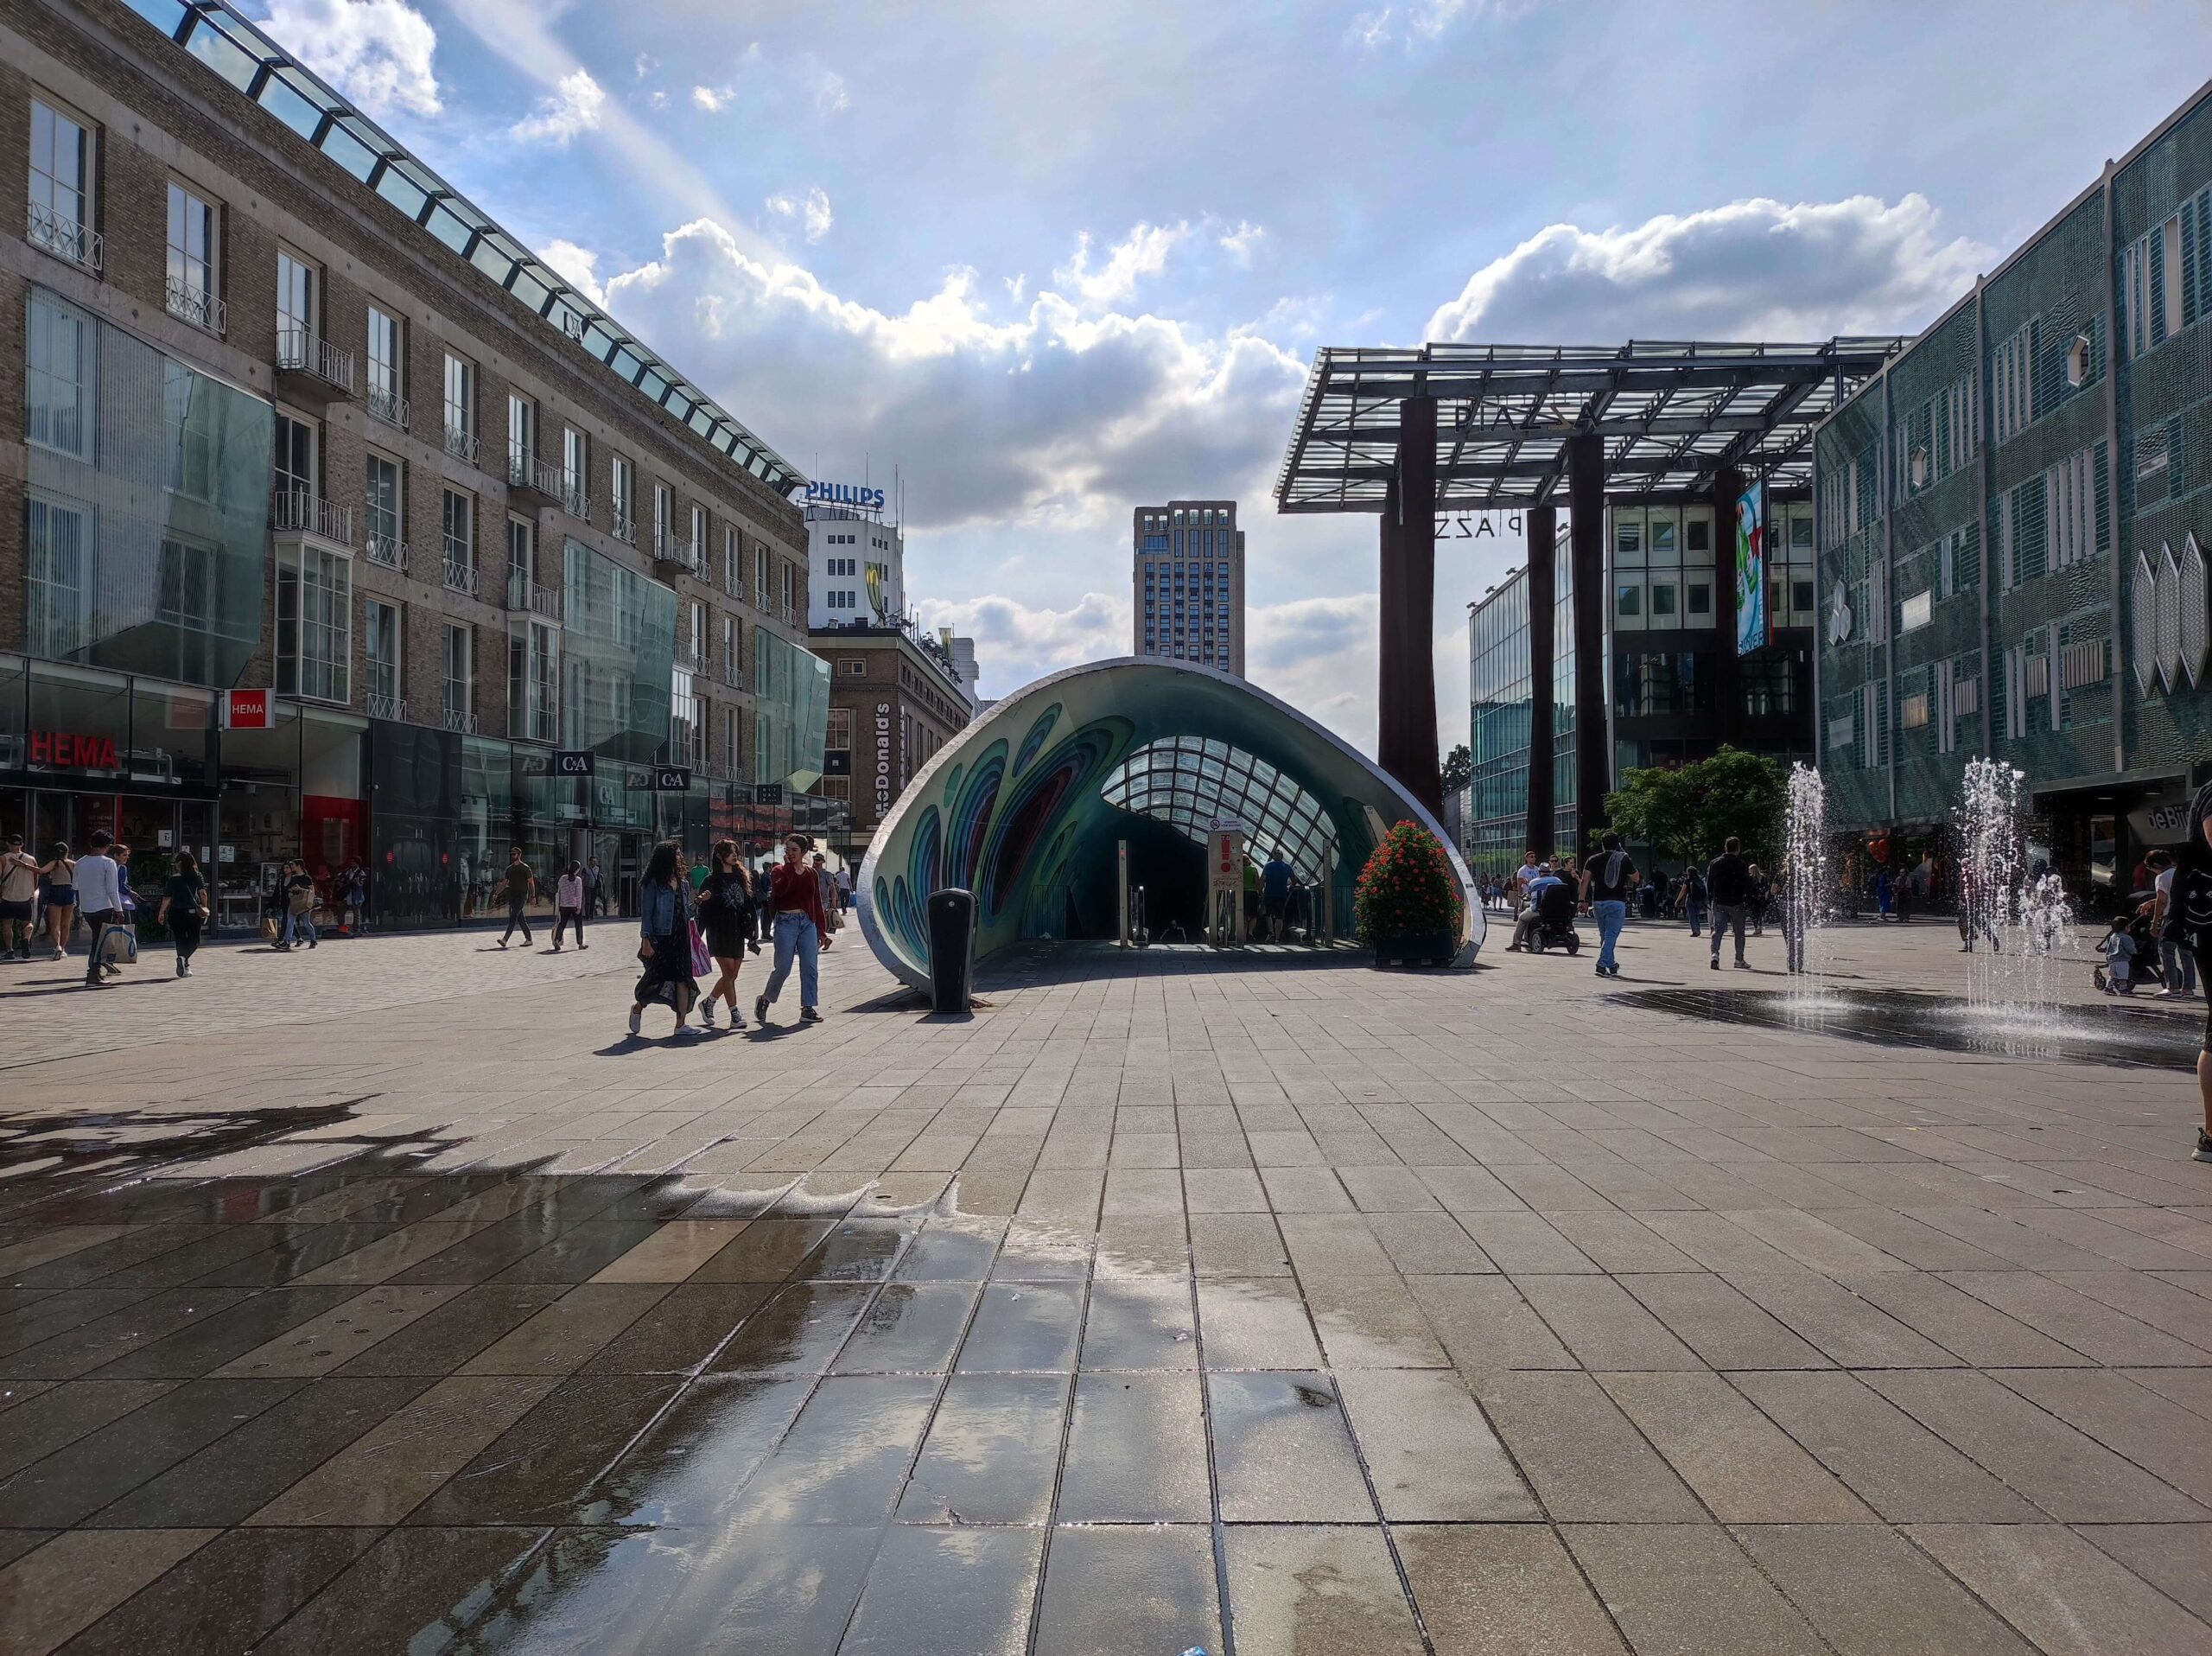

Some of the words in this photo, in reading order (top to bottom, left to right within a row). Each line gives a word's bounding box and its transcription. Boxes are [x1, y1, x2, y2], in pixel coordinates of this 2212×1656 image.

[1455, 402, 1598, 432] PIAZZA
[805, 481, 885, 506] PHILIPS
[232, 704, 264, 714] HEMA
[30, 729, 118, 771] HEMA
[562, 756, 588, 771] C&A
[661, 774, 684, 787] C&A
